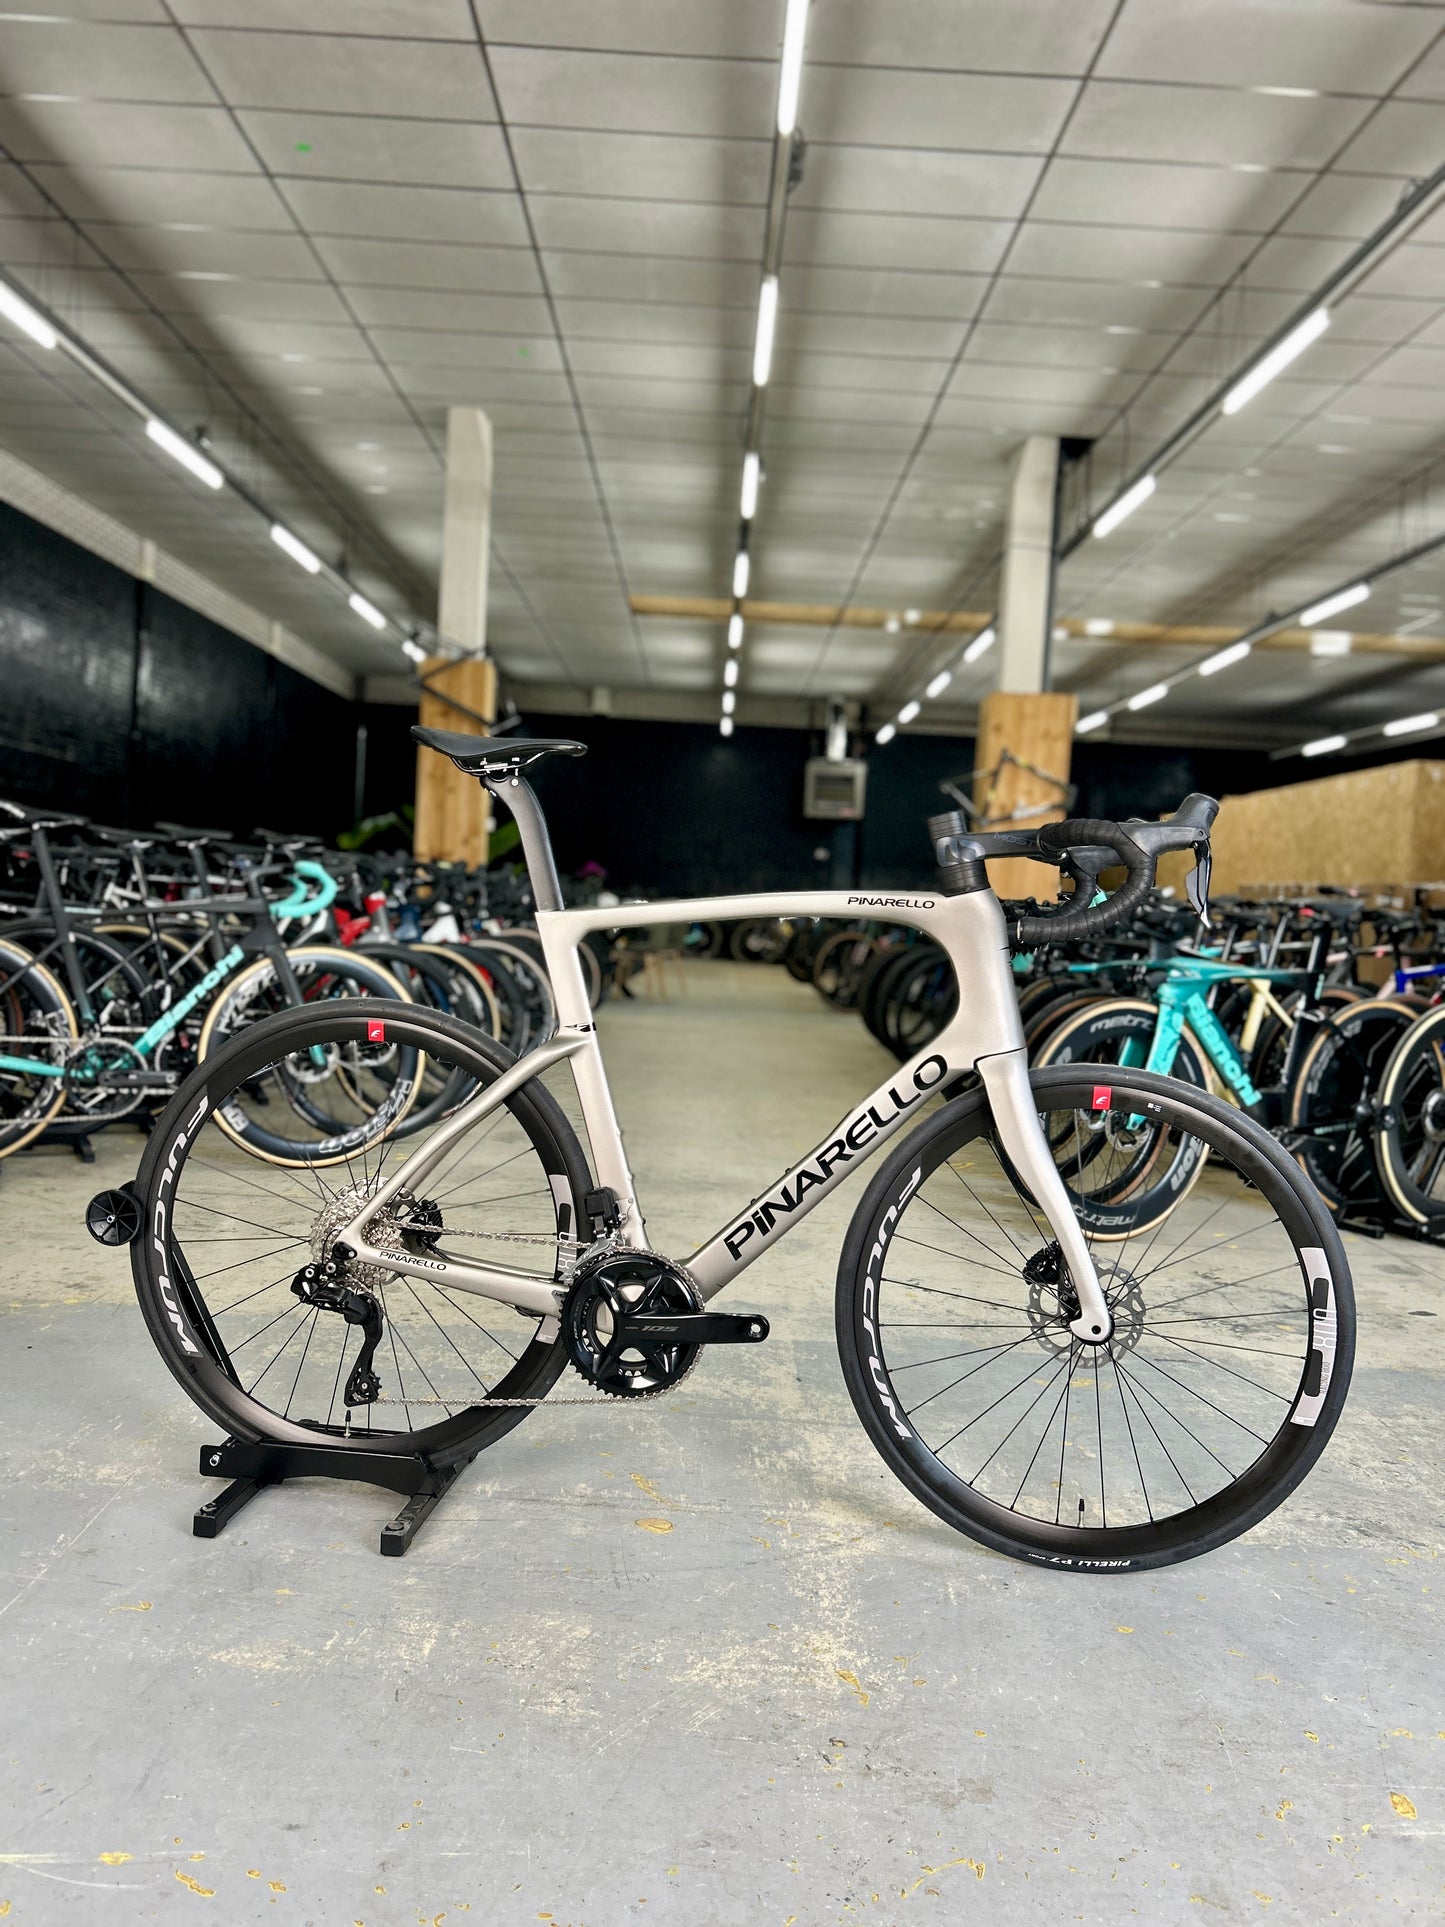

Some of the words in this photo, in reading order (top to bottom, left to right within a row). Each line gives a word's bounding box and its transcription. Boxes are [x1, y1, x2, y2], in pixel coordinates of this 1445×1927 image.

[847, 896, 936, 909] PINARELLO
[144, 944, 245, 1049] Bianchi
[1185, 992, 1264, 1107] Bianchi
[723, 1054, 948, 1261] PINARELLO
[154, 1096, 209, 1353] FULCRUM
[379, 1251, 447, 1271] PINARELLO
[863, 1166, 922, 1438] FULCRUM
[1049, 1556, 1073, 1565] P7
